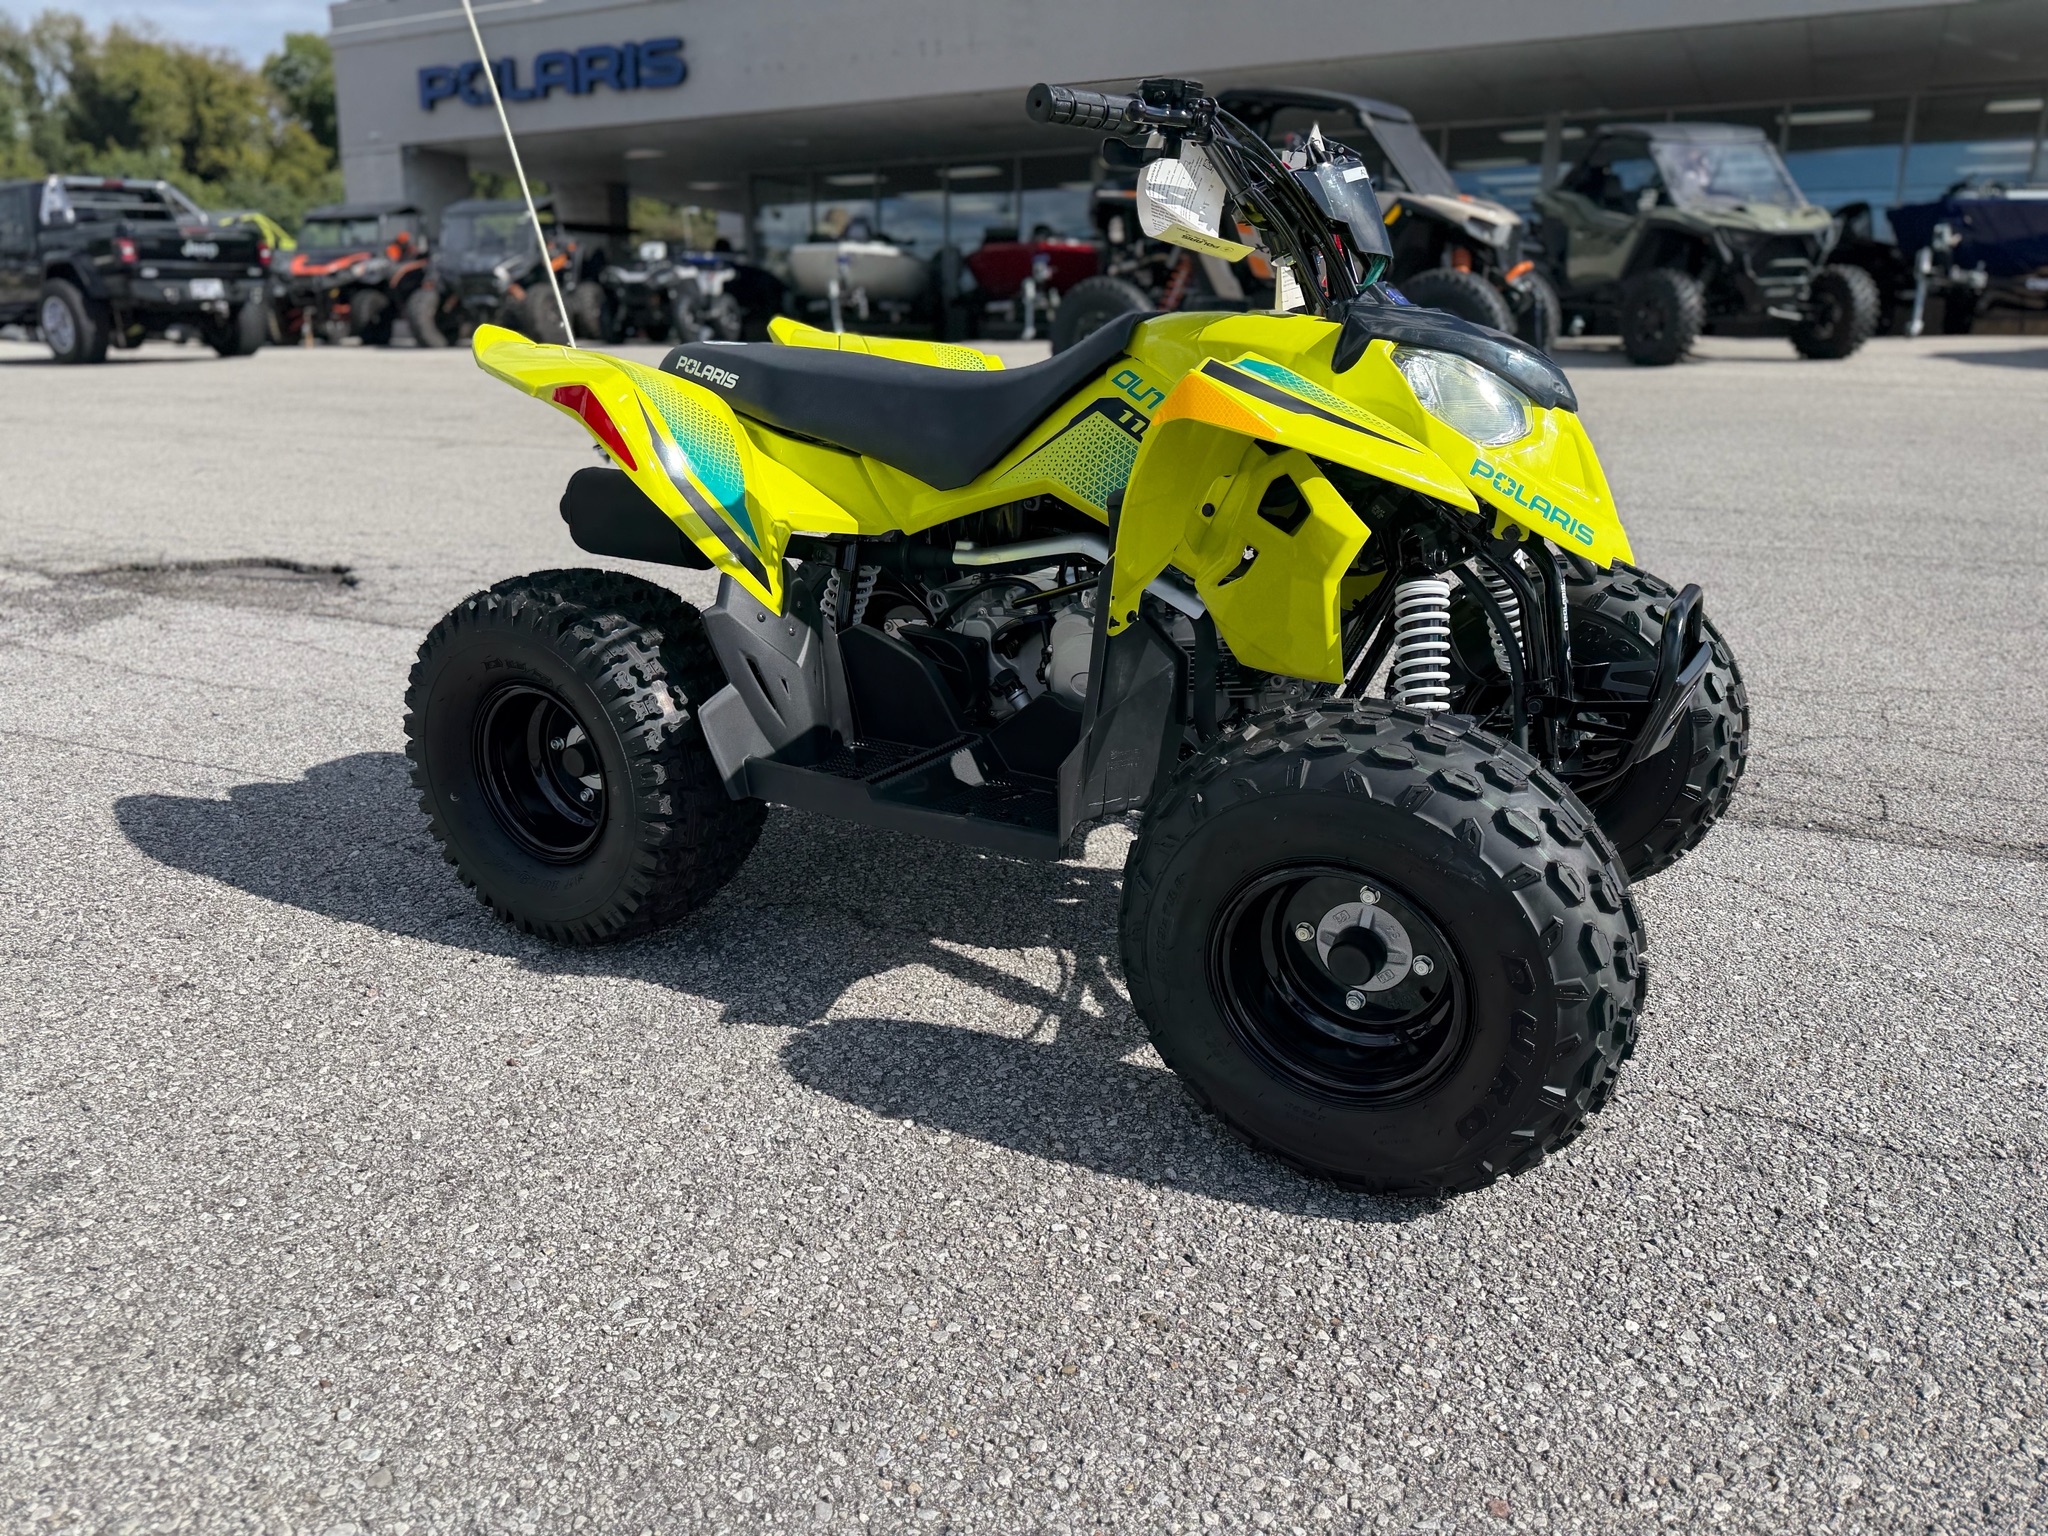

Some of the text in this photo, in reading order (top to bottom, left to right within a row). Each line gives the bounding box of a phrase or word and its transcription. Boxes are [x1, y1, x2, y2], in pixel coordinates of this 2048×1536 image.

[418, 37, 688, 111] POLARIS
[675, 355, 740, 389] POLARIS
[1469, 458, 1596, 546] POLARIS
